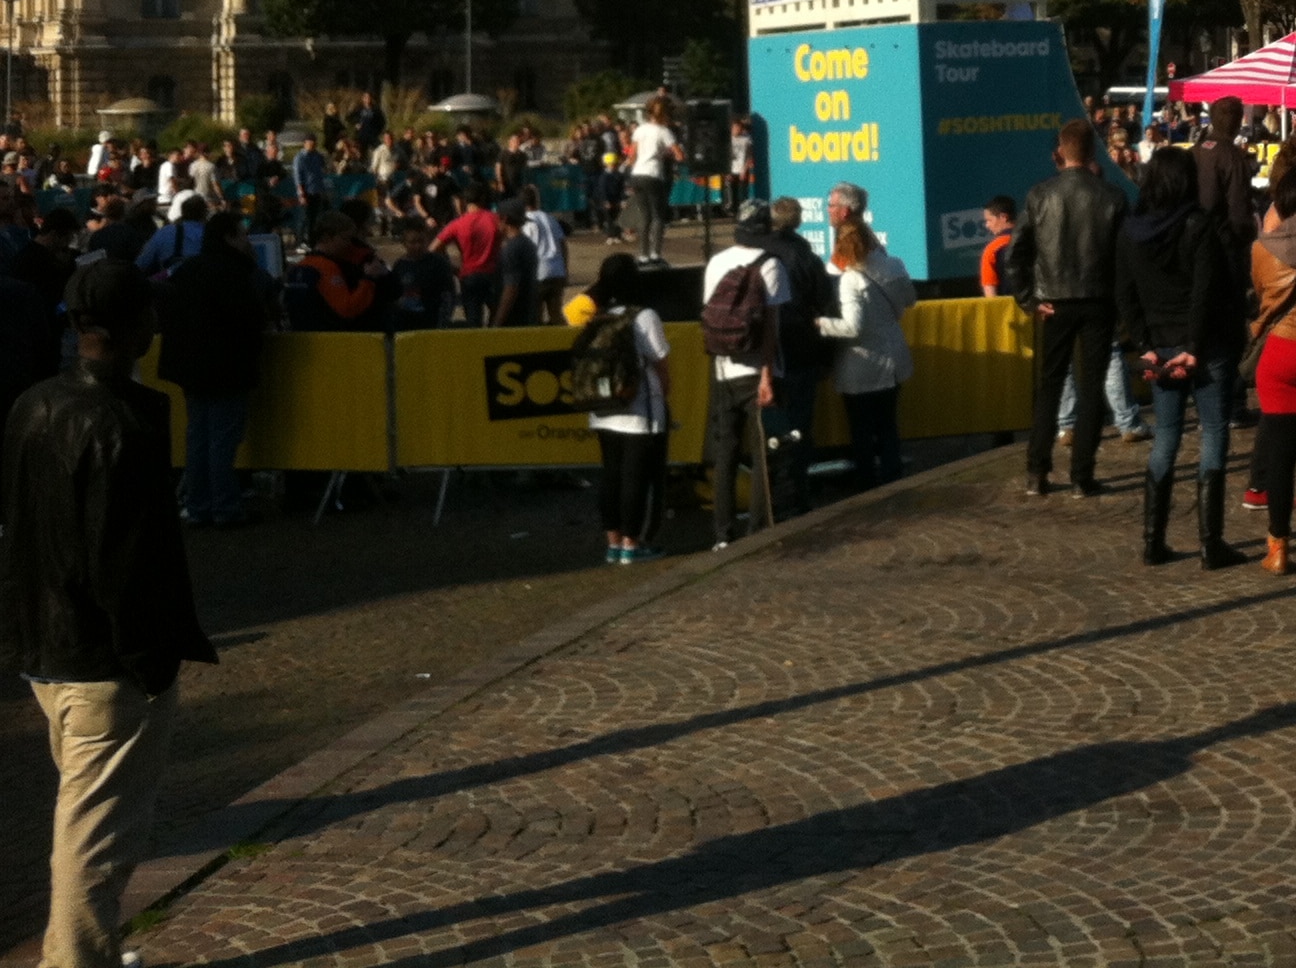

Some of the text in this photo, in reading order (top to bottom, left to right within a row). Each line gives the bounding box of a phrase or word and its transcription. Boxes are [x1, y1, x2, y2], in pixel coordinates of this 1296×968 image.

[794, 43, 869, 82] Come
[934, 38, 1050, 59] Skateboard
[934, 63, 979, 83] Tour
[815, 89, 850, 122] on
[789, 122, 880, 162] board!
[947, 215, 990, 241] Sos
[496, 361, 575, 406] Sos
